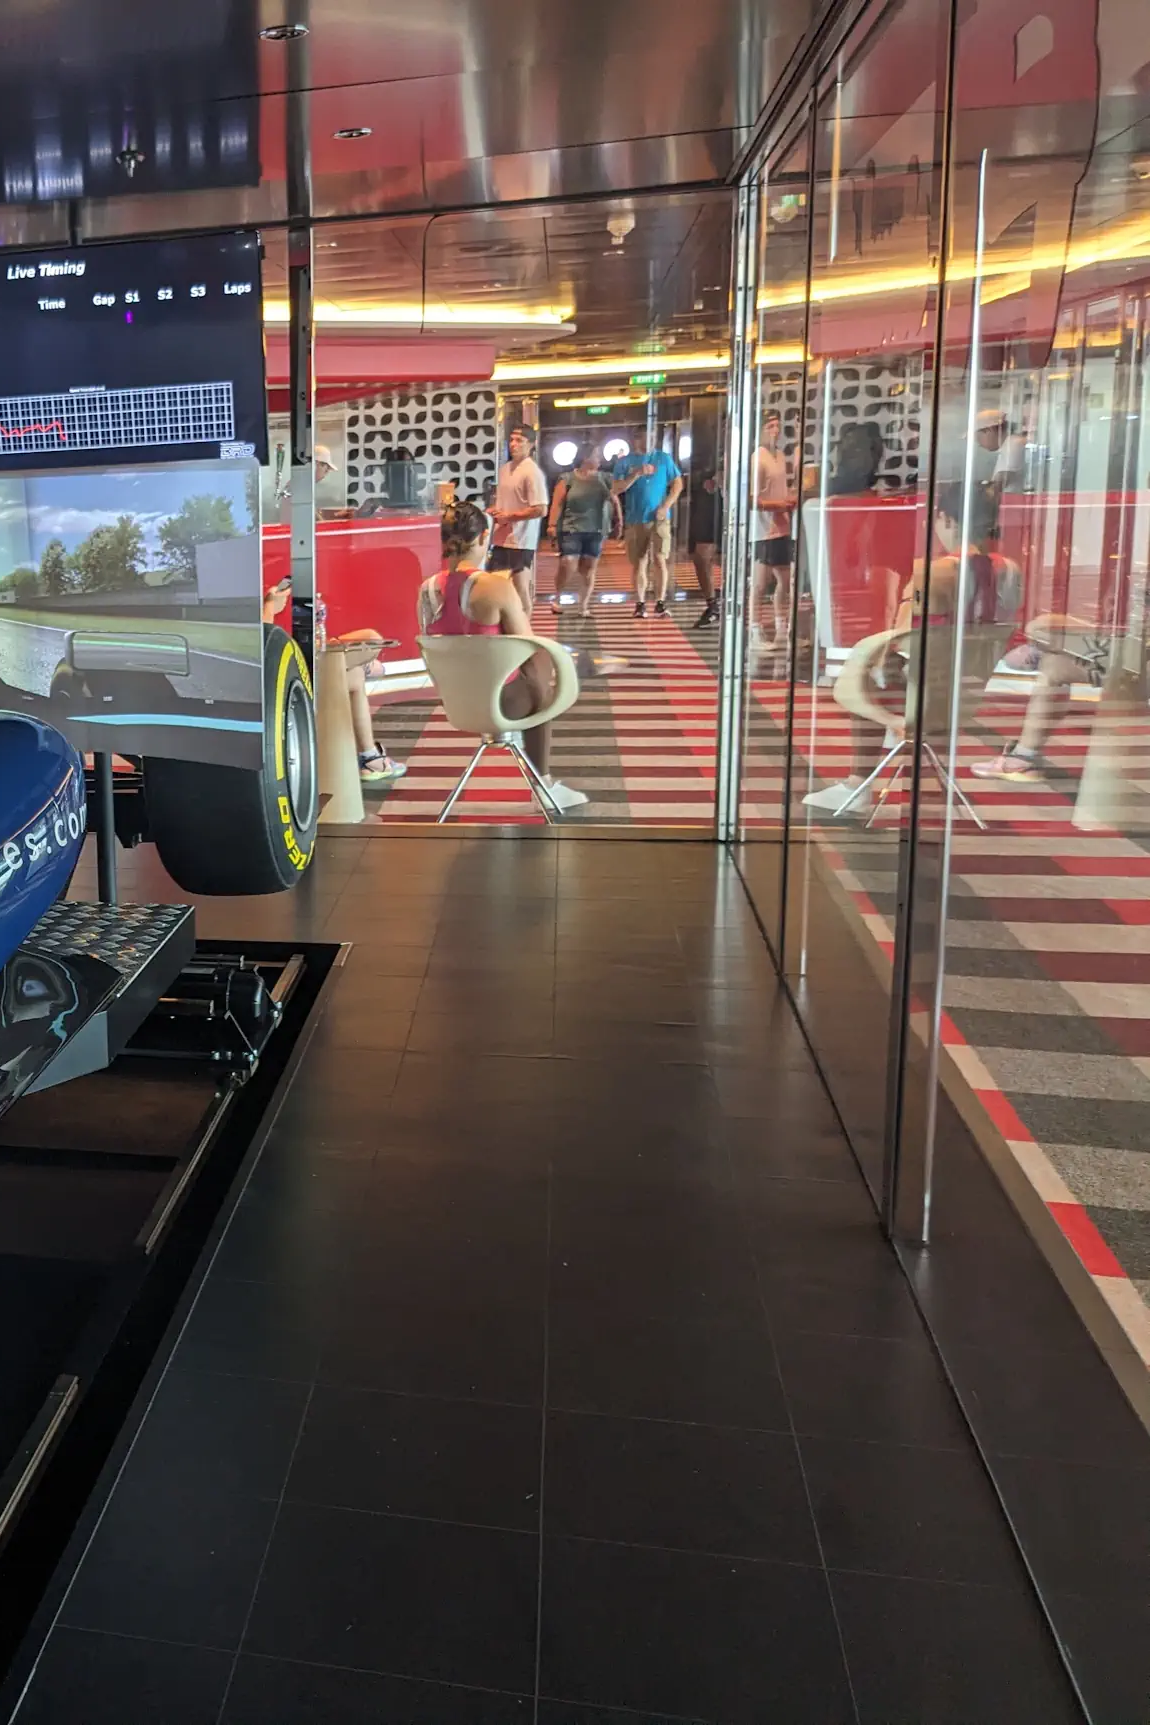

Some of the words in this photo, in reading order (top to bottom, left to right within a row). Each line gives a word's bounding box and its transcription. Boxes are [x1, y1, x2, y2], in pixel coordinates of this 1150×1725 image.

[7, 265, 36, 280] Live
[38, 260, 86, 278] Timing
[38, 298, 66, 311] Time
[93, 294, 116, 307] Gap
[125, 291, 140, 303] S1
[157, 288, 173, 300] S2
[190, 285, 206, 298] S3
[223, 282, 252, 296] Laps
